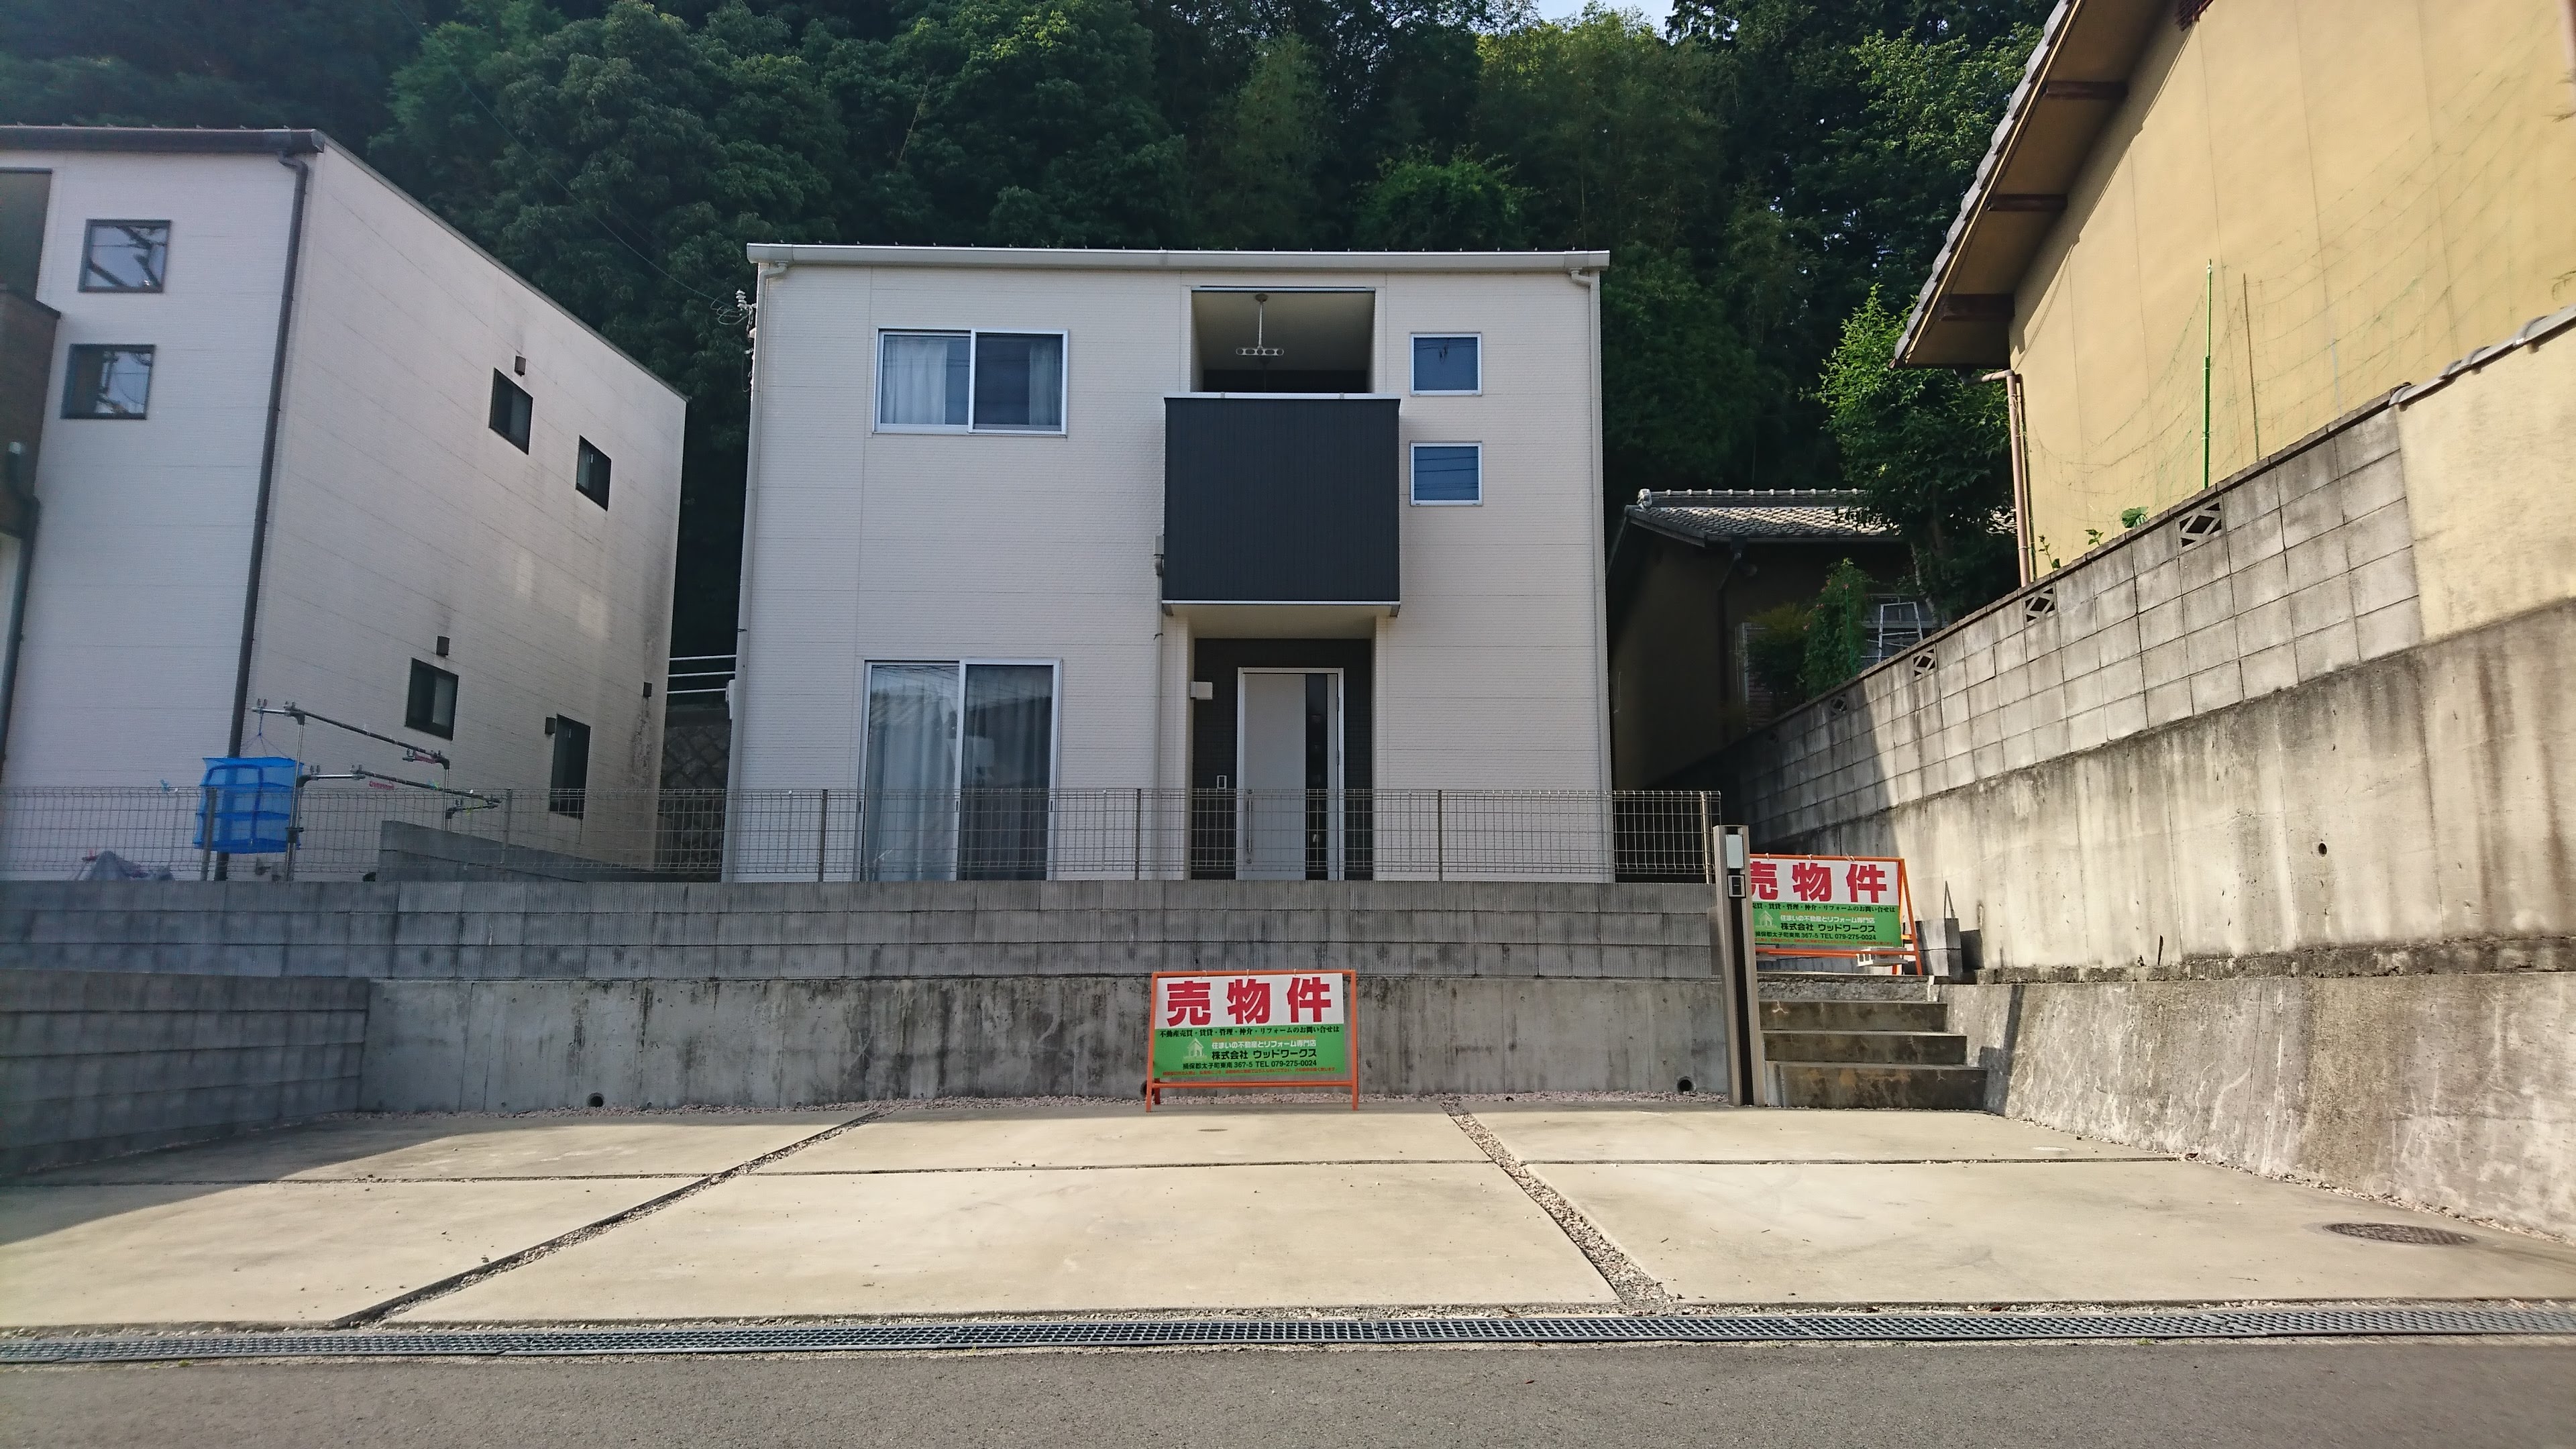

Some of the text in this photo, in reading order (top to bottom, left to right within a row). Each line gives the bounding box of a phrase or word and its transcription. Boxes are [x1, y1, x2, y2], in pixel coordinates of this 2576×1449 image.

[1750, 861, 1887, 904] 売物件
[1780, 922, 1876, 932] 株式会社 ウッドワークス
[1166, 977, 1333, 1027] 売物件
[1211, 1039, 1317, 1049] 住まいの不動産とリフォーム専門店
[1212, 1048, 1318, 1060] 株式会社 ウッドワークス
[1255, 1060, 1270, 1068] TEL
[1271, 1059, 1318, 1067] 079-275-0024
